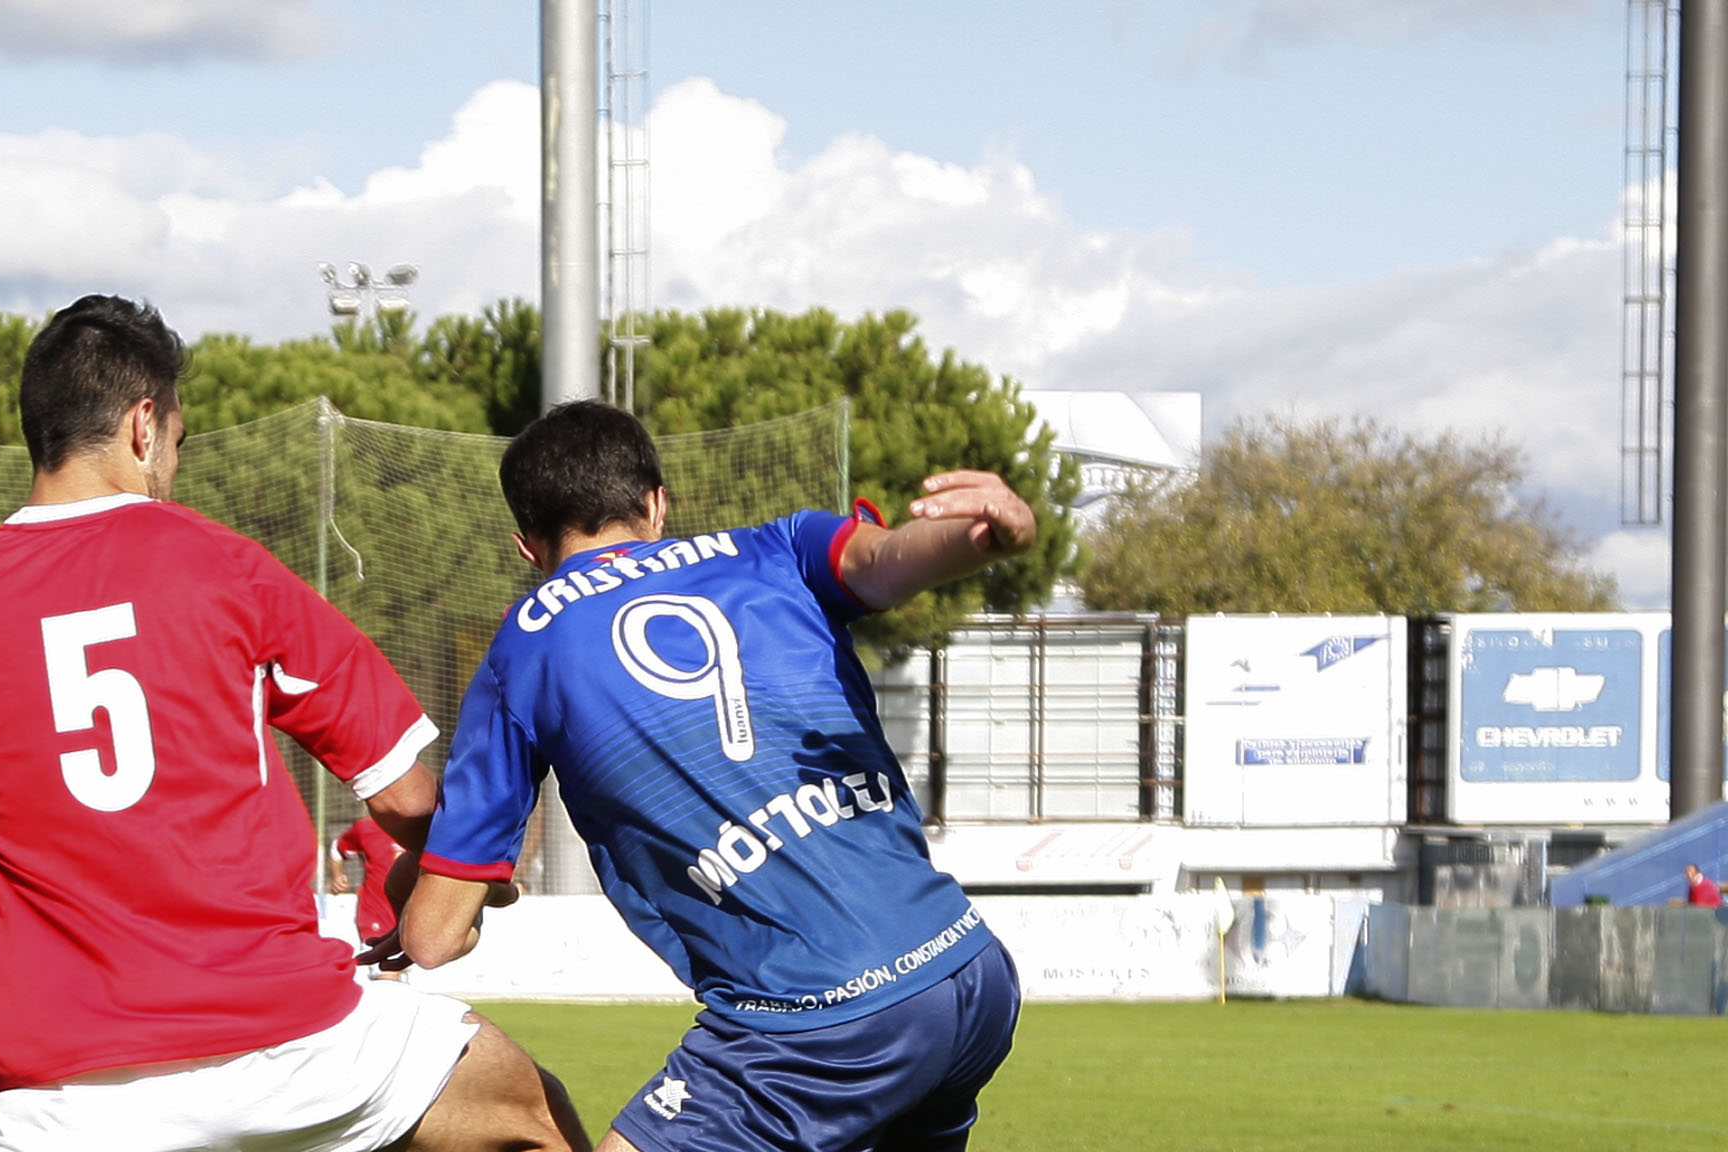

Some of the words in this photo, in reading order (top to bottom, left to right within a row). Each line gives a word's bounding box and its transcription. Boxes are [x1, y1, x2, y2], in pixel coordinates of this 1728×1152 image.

[517, 532, 740, 633] CRISTIAN
[40, 601, 157, 813] 5
[610, 593, 756, 763] 9
[1476, 726, 1623, 748] CHEVROLET
[824, 968, 897, 1005] PASIÓN,
